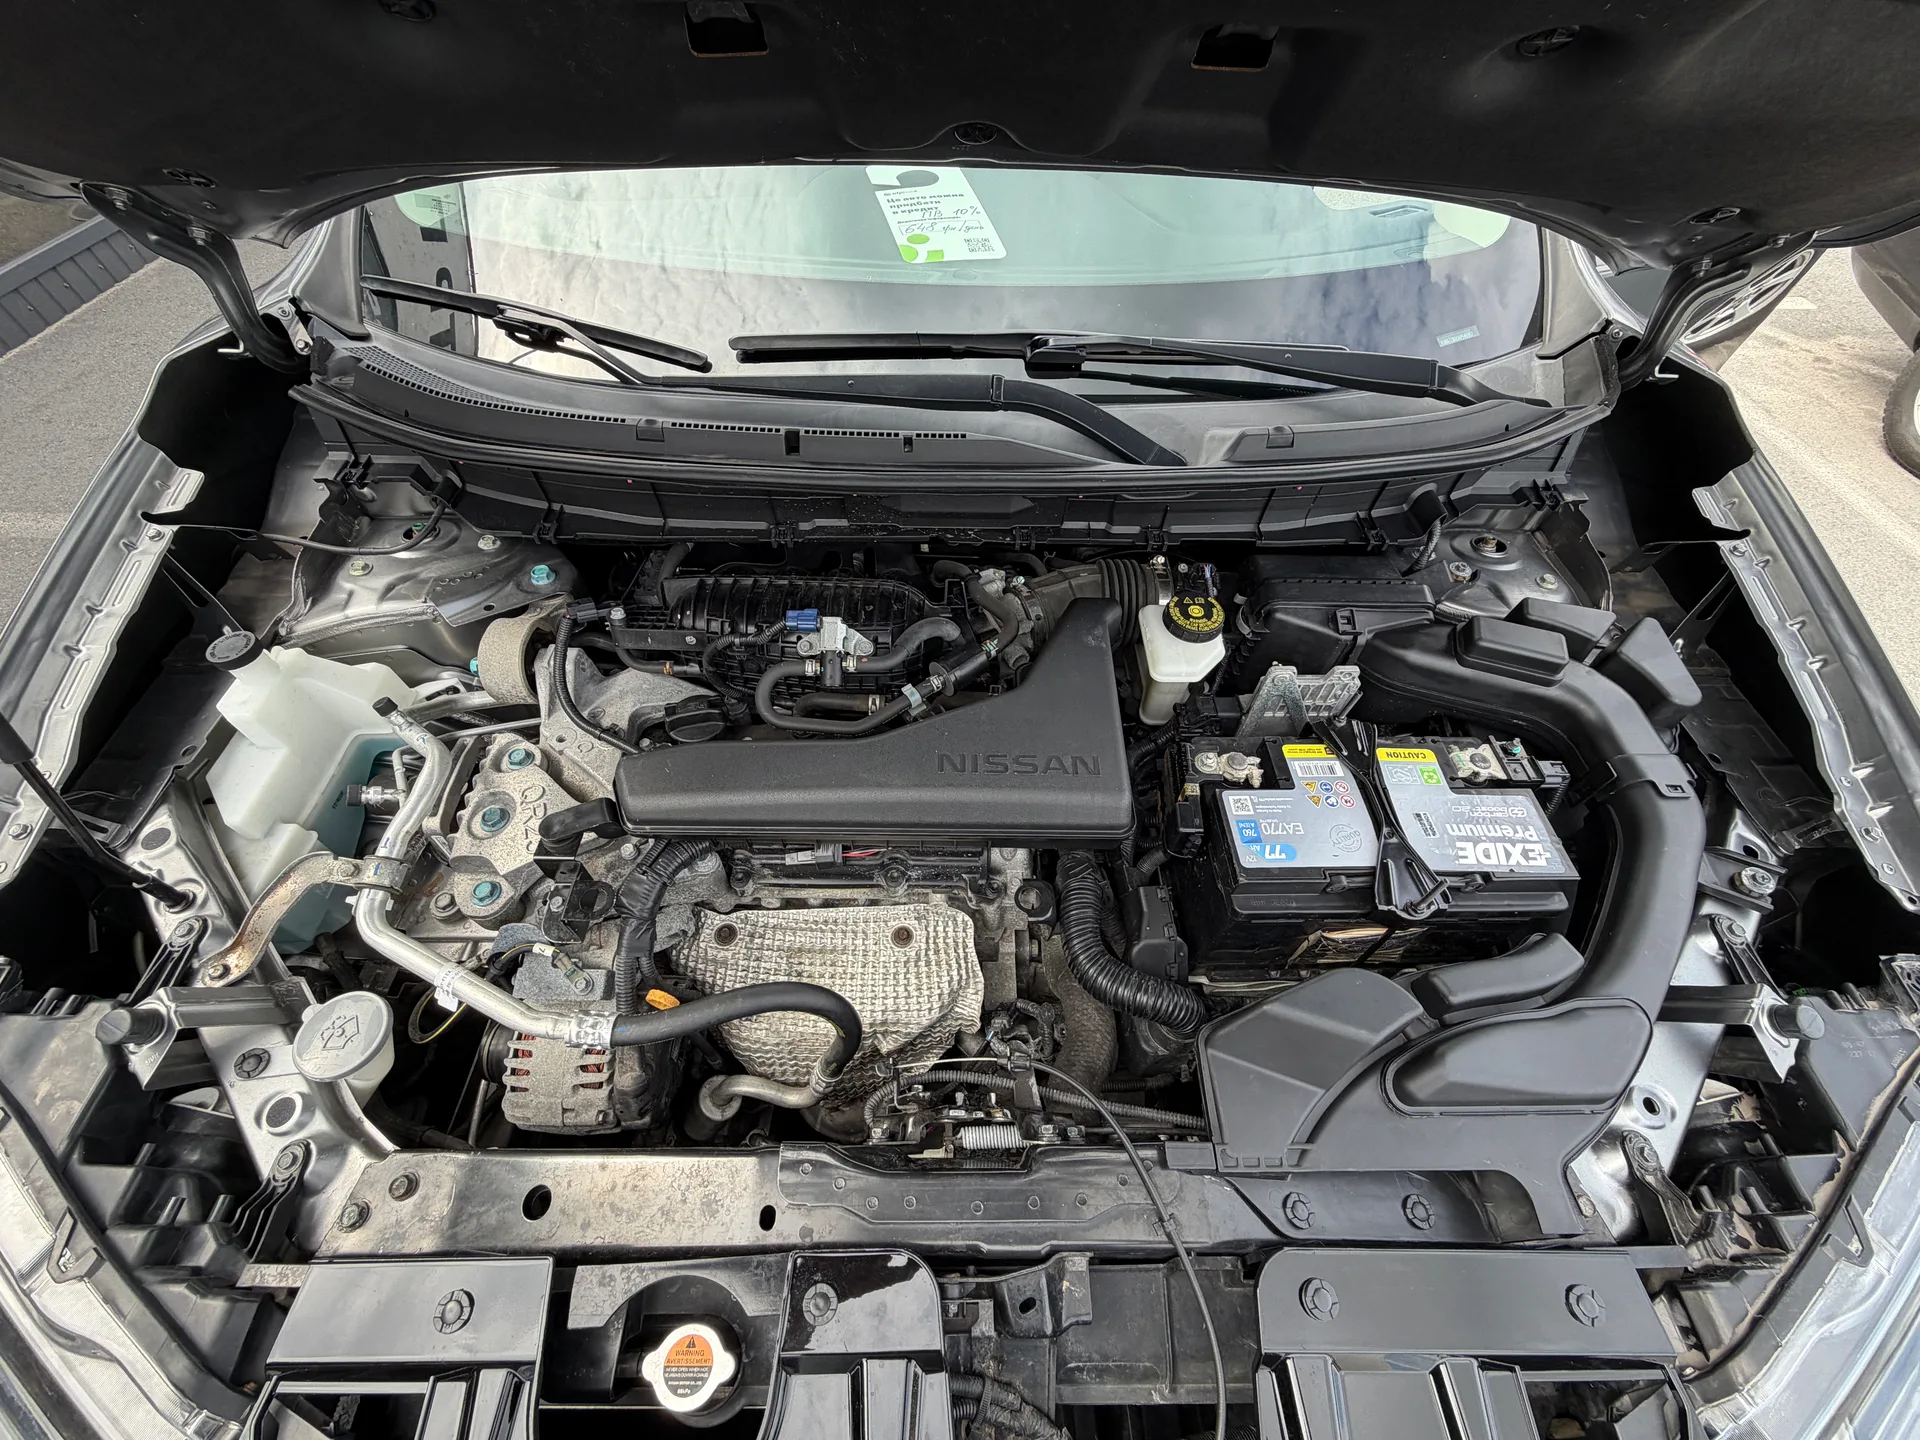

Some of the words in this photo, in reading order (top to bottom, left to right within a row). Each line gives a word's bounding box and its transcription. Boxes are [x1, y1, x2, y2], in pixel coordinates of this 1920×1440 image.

[889, 200, 941, 209] придбати
[900, 206, 939, 215] кредит
[953, 205, 981, 216] 10%
[905, 221, 938, 234] 648
[1385, 751, 1427, 760] CAUTION
[937, 753, 1101, 776] NISSAN
[1242, 828, 1258, 837] 760
[1261, 822, 1305, 836] EA770
[1445, 823, 1539, 842] Premium
[1331, 830, 1361, 847] QUALITY
[1245, 854, 1258, 863] 12V
[1264, 844, 1287, 860] 77
[1455, 841, 1552, 867] EXIDE
